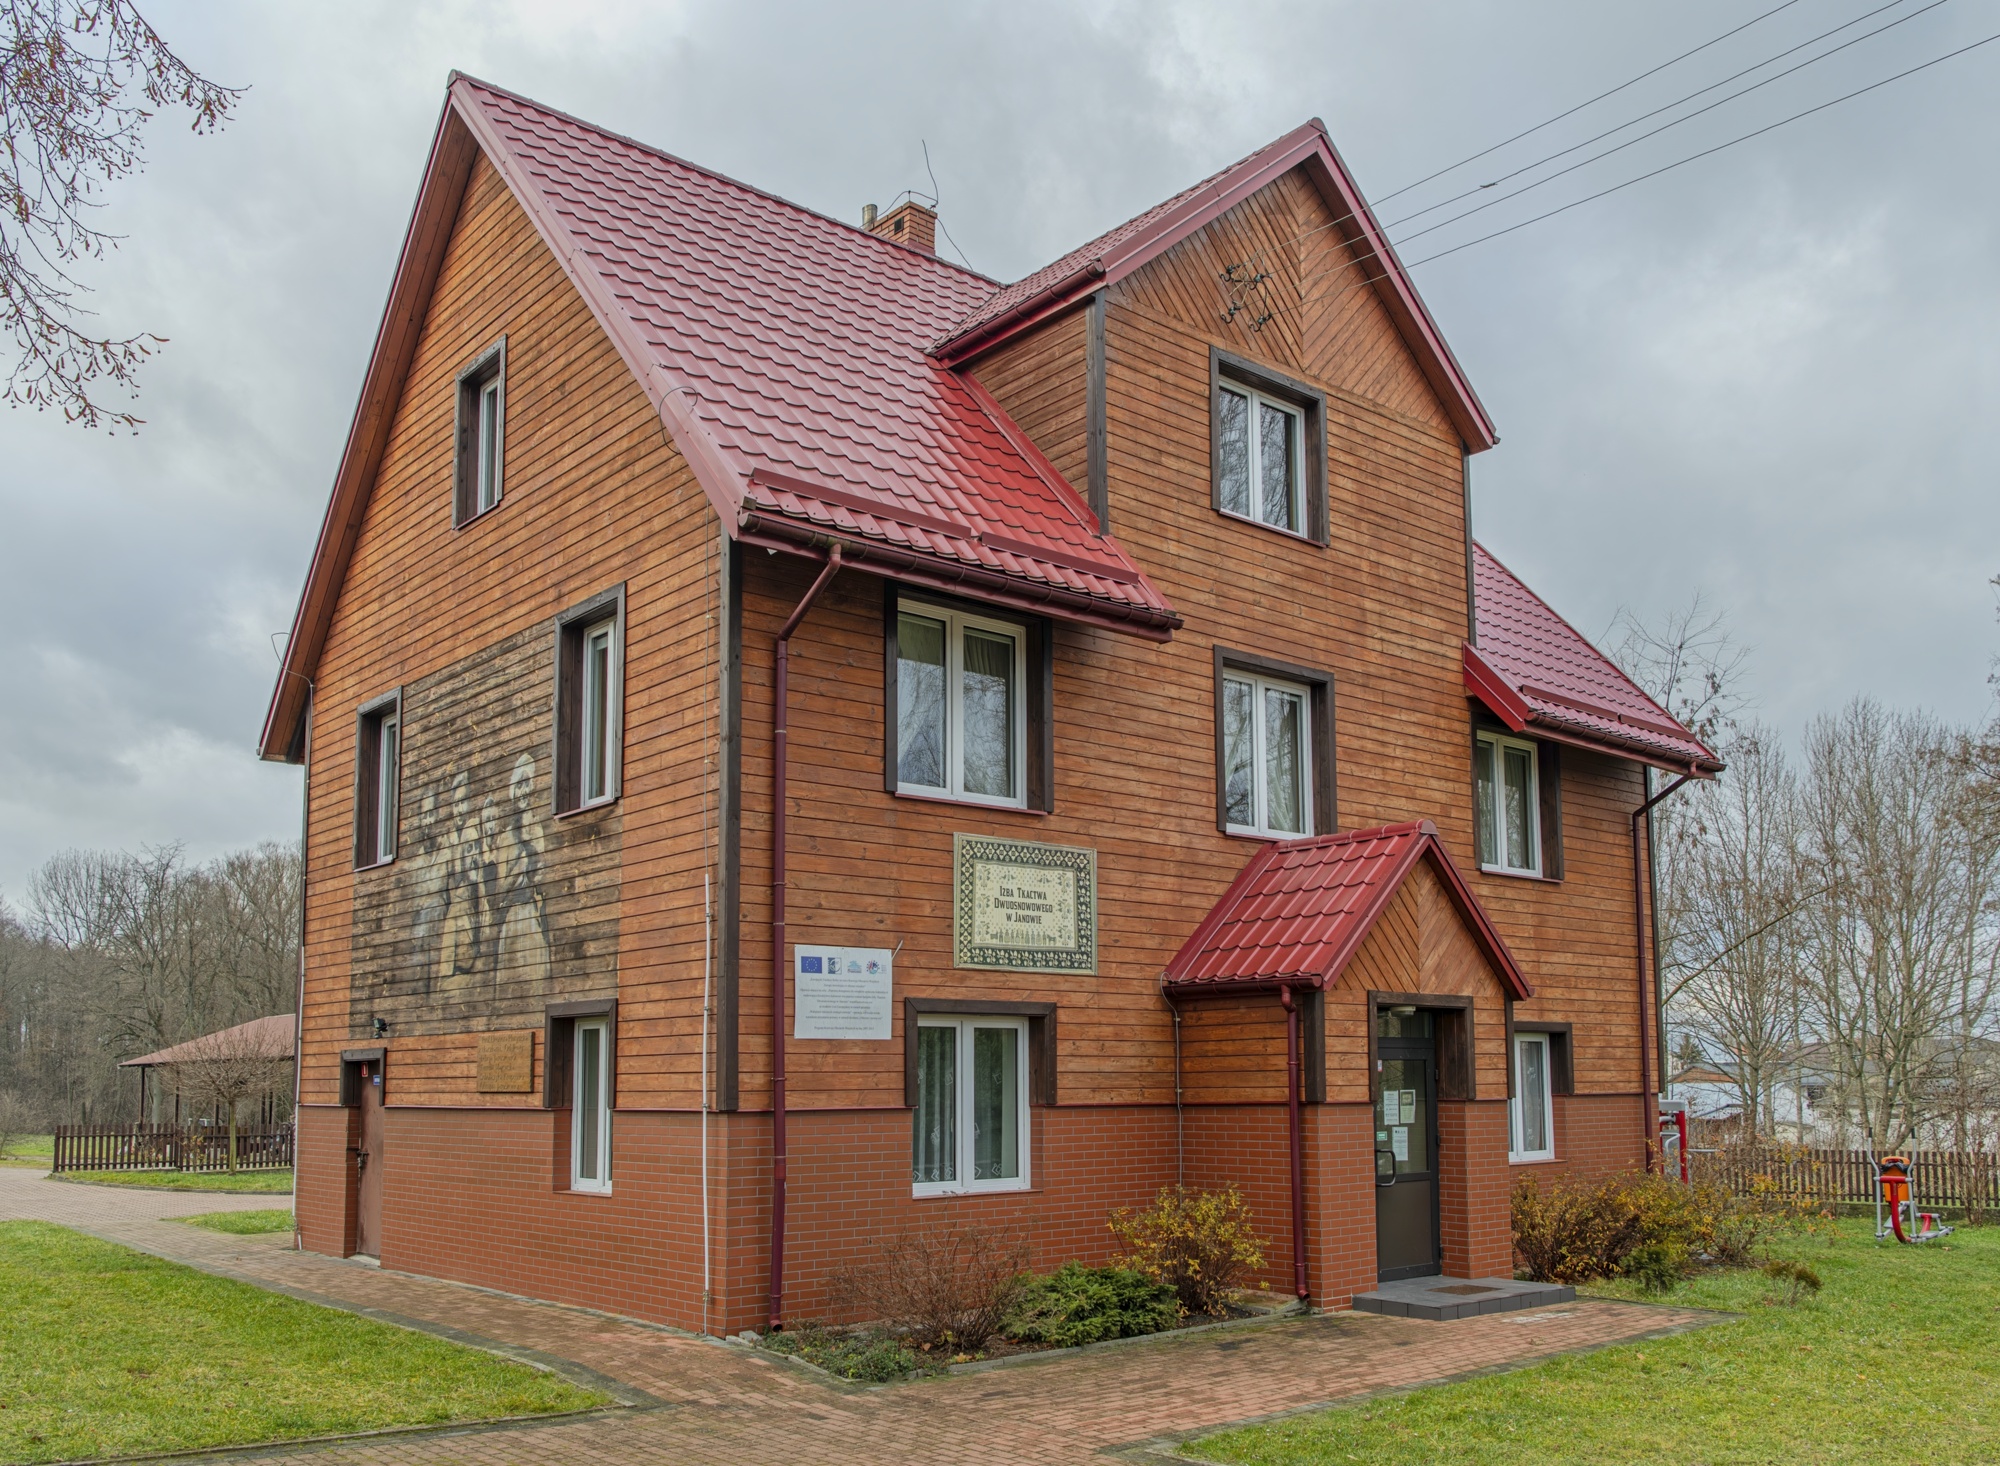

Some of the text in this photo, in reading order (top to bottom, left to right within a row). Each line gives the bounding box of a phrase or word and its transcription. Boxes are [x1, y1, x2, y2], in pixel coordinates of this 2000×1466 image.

[1000, 886, 1047, 900] IZBA TKACTWA
[994, 898, 1053, 912] DWUOSNOWOWEGO
[1014, 912, 1042, 924] JANOWIE
